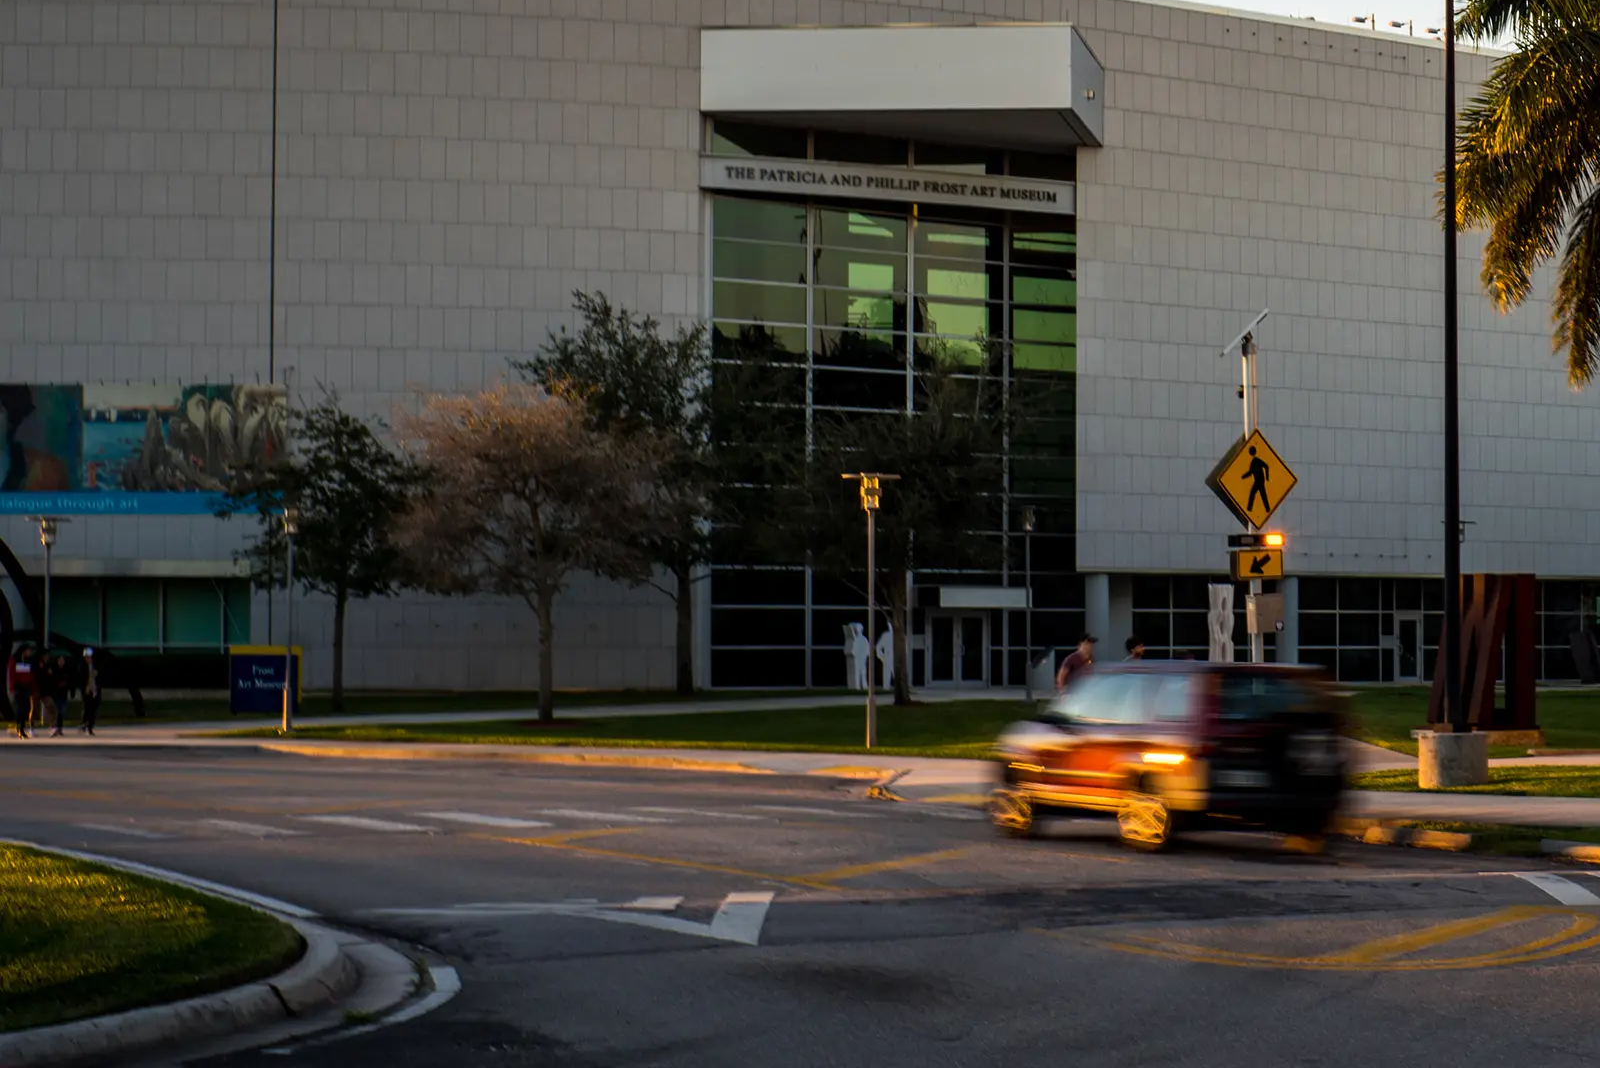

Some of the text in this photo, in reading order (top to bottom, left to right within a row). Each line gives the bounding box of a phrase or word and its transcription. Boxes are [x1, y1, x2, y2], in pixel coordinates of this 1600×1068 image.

[725, 166, 1057, 204] THE PATRICIA AND PHILLIP FROST ART MUSEUM
[57, 497, 114, 511] through
[119, 498, 138, 509] art
[255, 678, 286, 690] Museu
